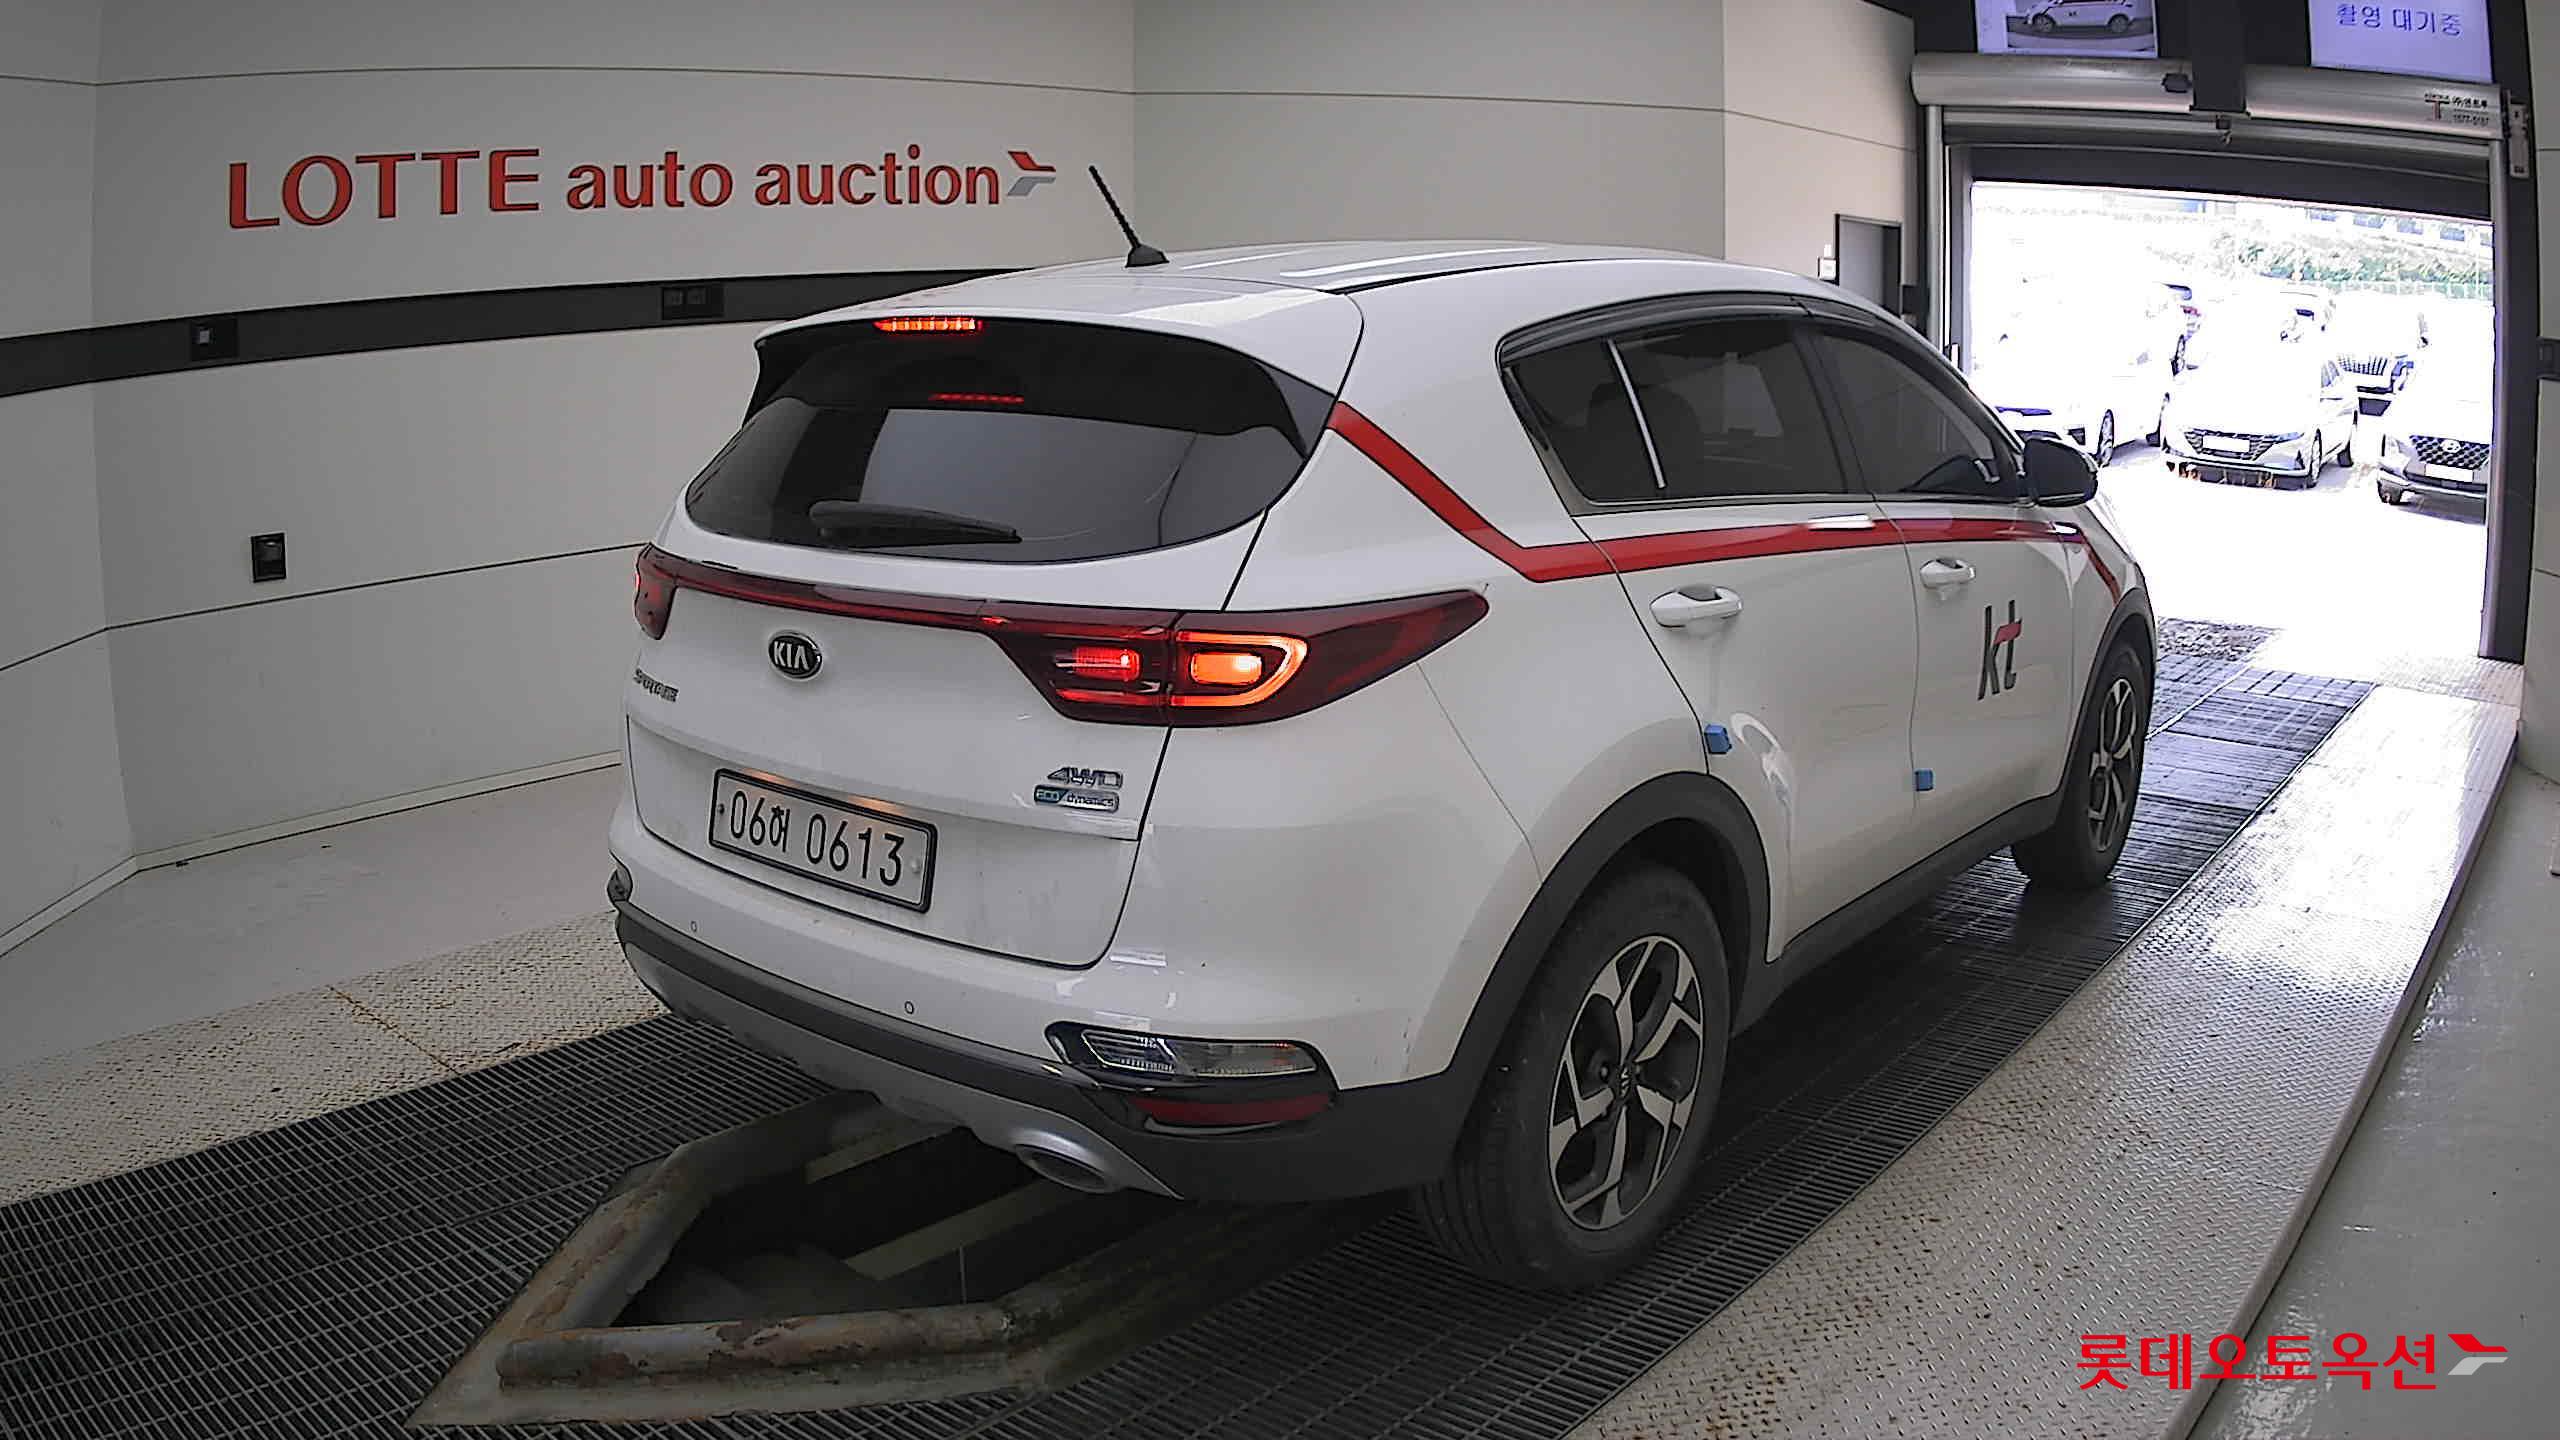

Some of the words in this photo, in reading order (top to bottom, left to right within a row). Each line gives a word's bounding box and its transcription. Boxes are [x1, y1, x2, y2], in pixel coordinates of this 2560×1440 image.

[2393, 9, 2460, 36] 대기중
[229, 148, 540, 229] LOTTE
[566, 150, 734, 210] auto
[753, 143, 1000, 206] auction
[773, 640, 810, 671] KIA
[1047, 766, 1123, 788] 4WD
[730, 790, 790, 853] 06허
[806, 813, 905, 887] 0613
